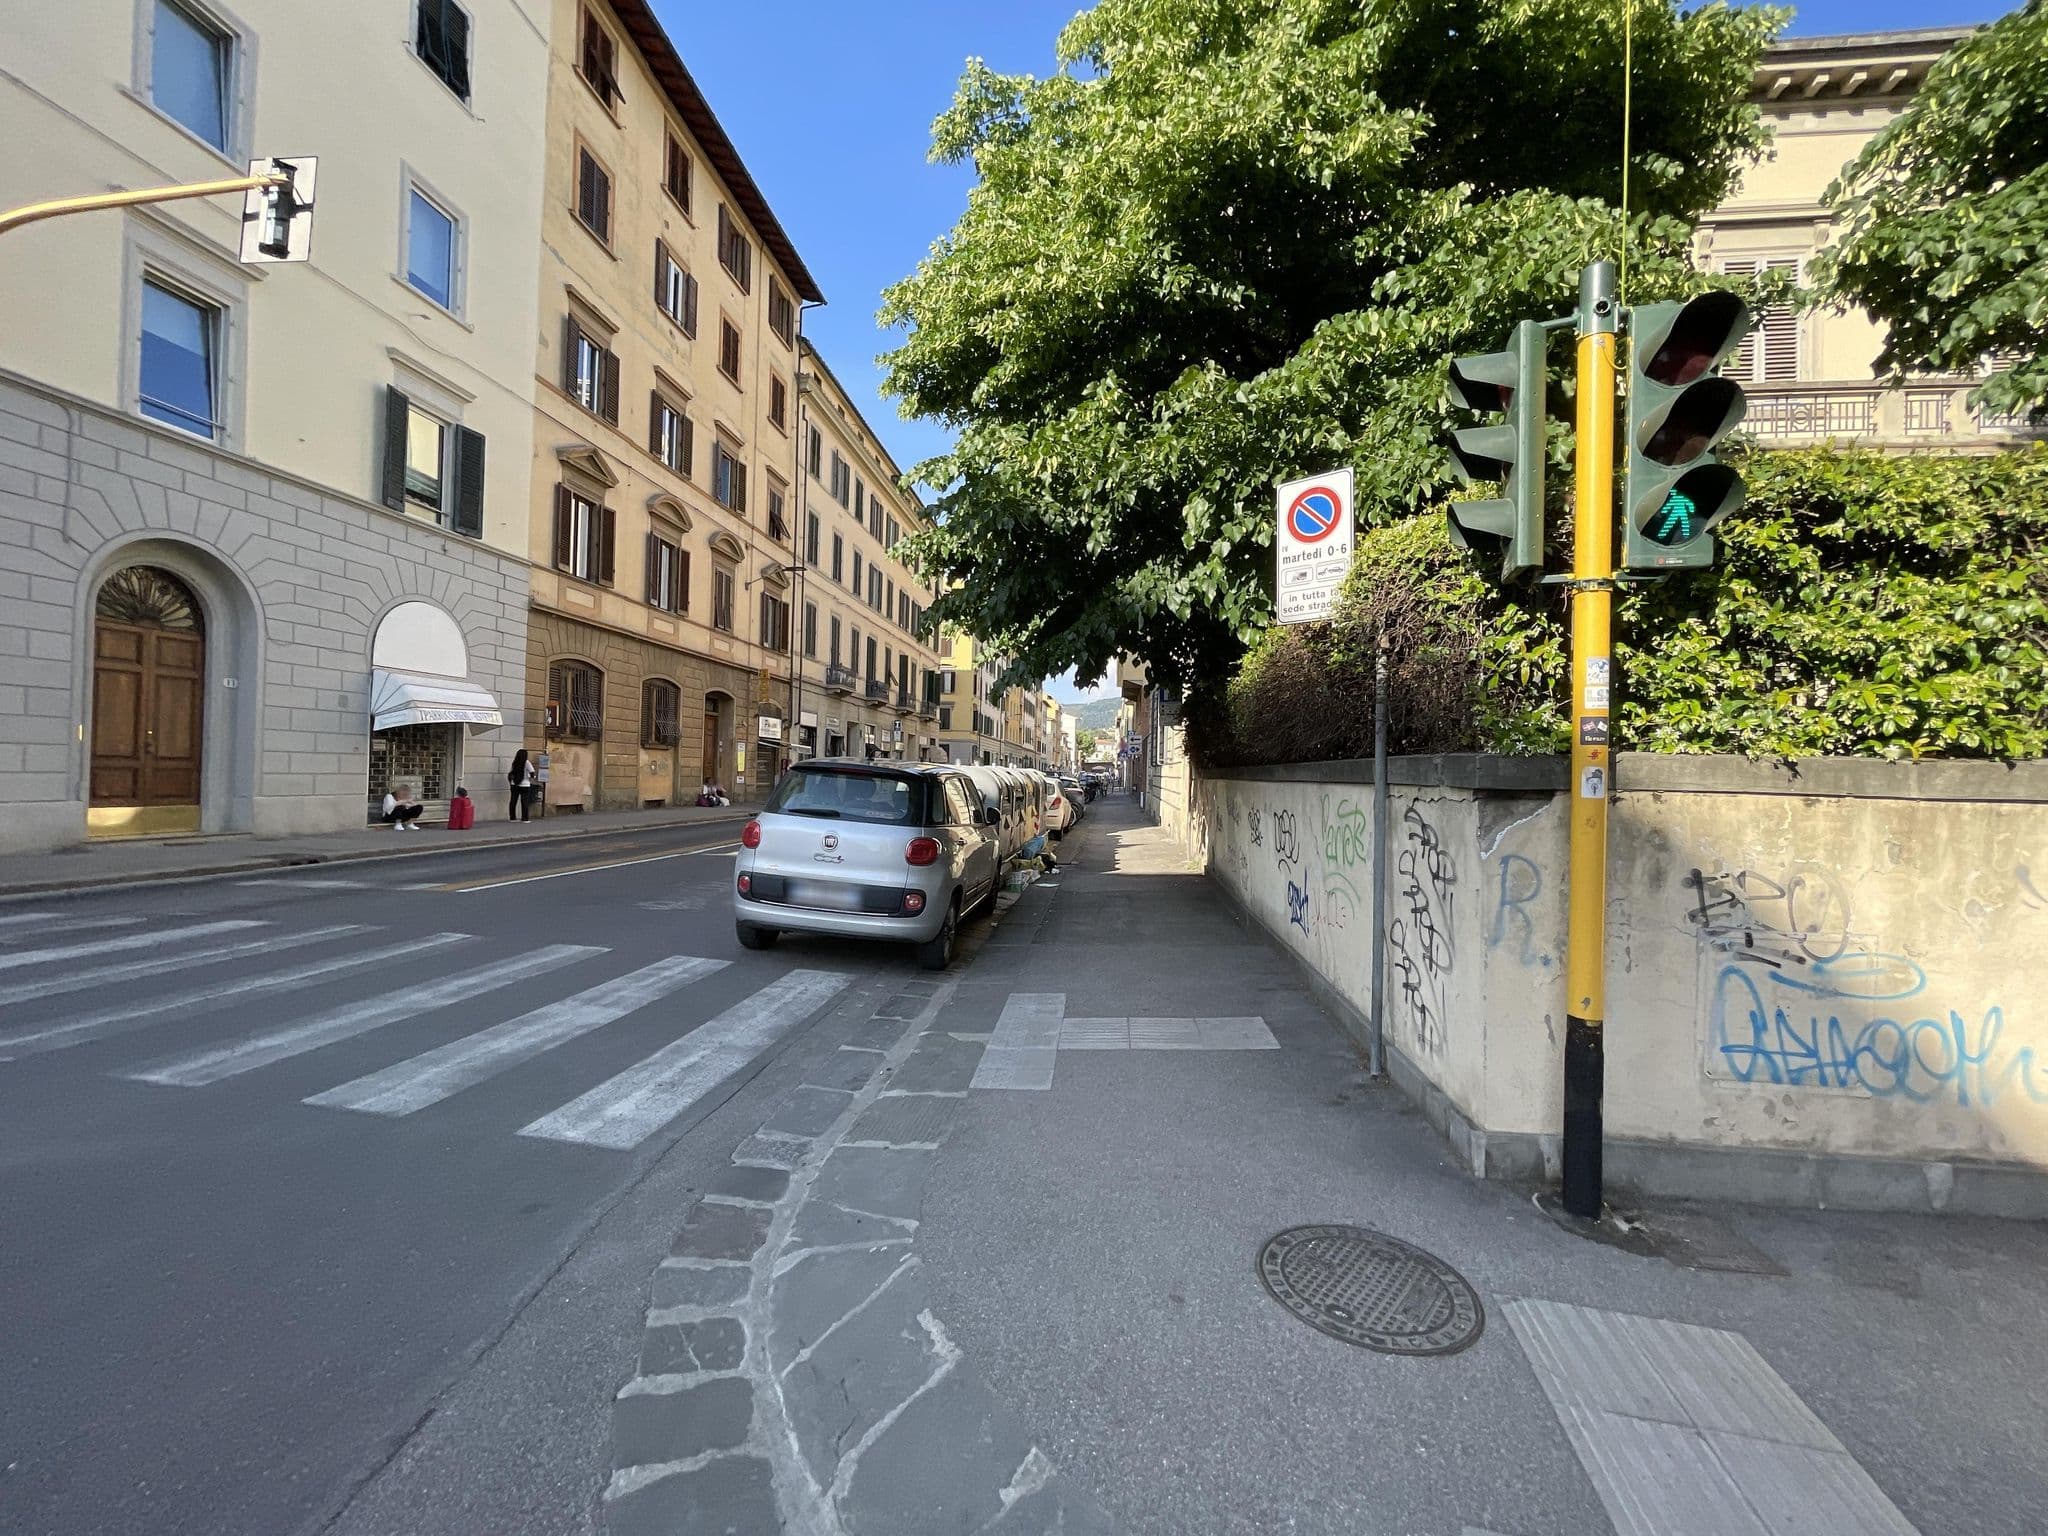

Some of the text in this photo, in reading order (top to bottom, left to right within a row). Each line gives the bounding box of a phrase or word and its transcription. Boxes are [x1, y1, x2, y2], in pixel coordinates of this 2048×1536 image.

[1289, 594, 1298, 603] in
[1302, 590, 1326, 601] tutta
[1282, 603, 1305, 614] sede
